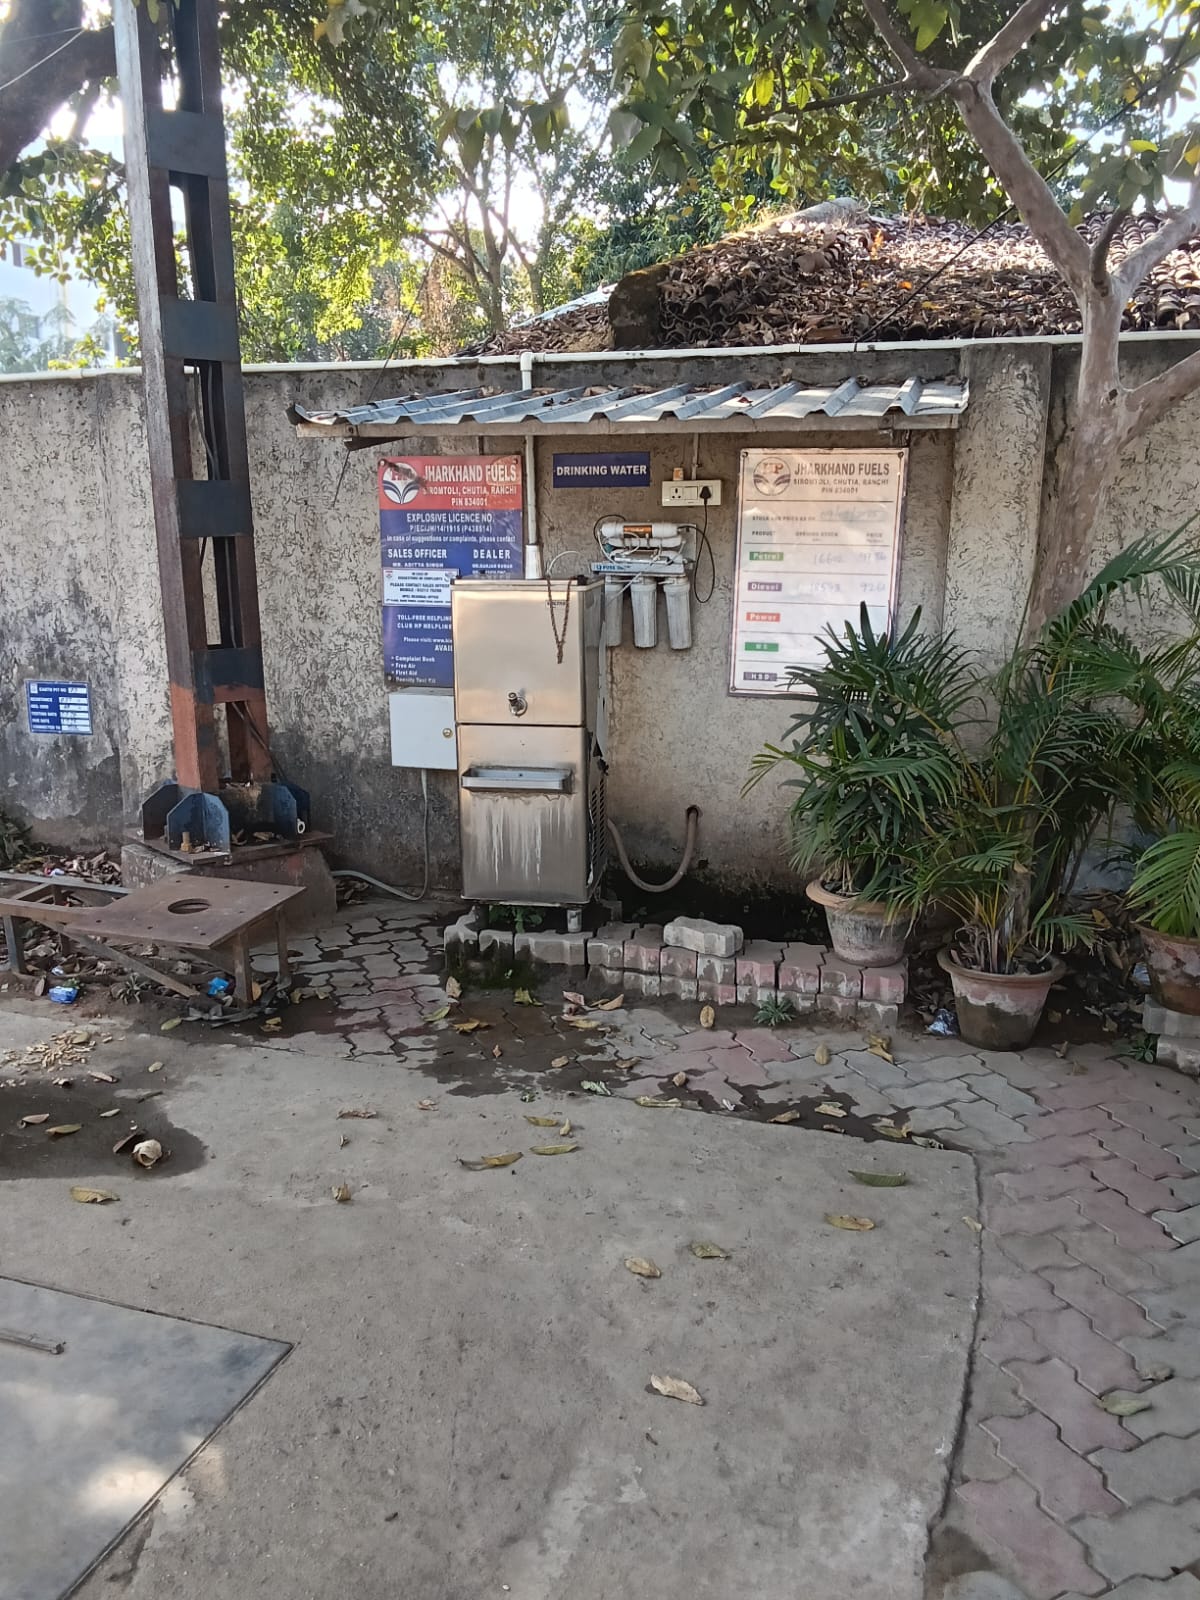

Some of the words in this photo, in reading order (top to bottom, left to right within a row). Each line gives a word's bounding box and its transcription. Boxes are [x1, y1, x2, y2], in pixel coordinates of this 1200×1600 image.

[424, 465, 483, 482] JHARKHAND
[485, 464, 517, 481] FUELS
[556, 465, 608, 476] DRINKING
[610, 464, 647, 475] WATER
[794, 463, 855, 475] JHARKHAND
[858, 463, 890, 476] FUELS
[451, 498, 463, 507] PIN
[406, 513, 448, 523] EXPLOSIVE
[448, 513, 480, 523] LICENCE
[387, 548, 415, 559] SALES
[414, 549, 448, 559] OFFICER
[473, 549, 511, 560] DEALER
[752, 552, 780, 561] Petrol
[751, 583, 779, 592] Diesel
[749, 613, 777, 621] Power
